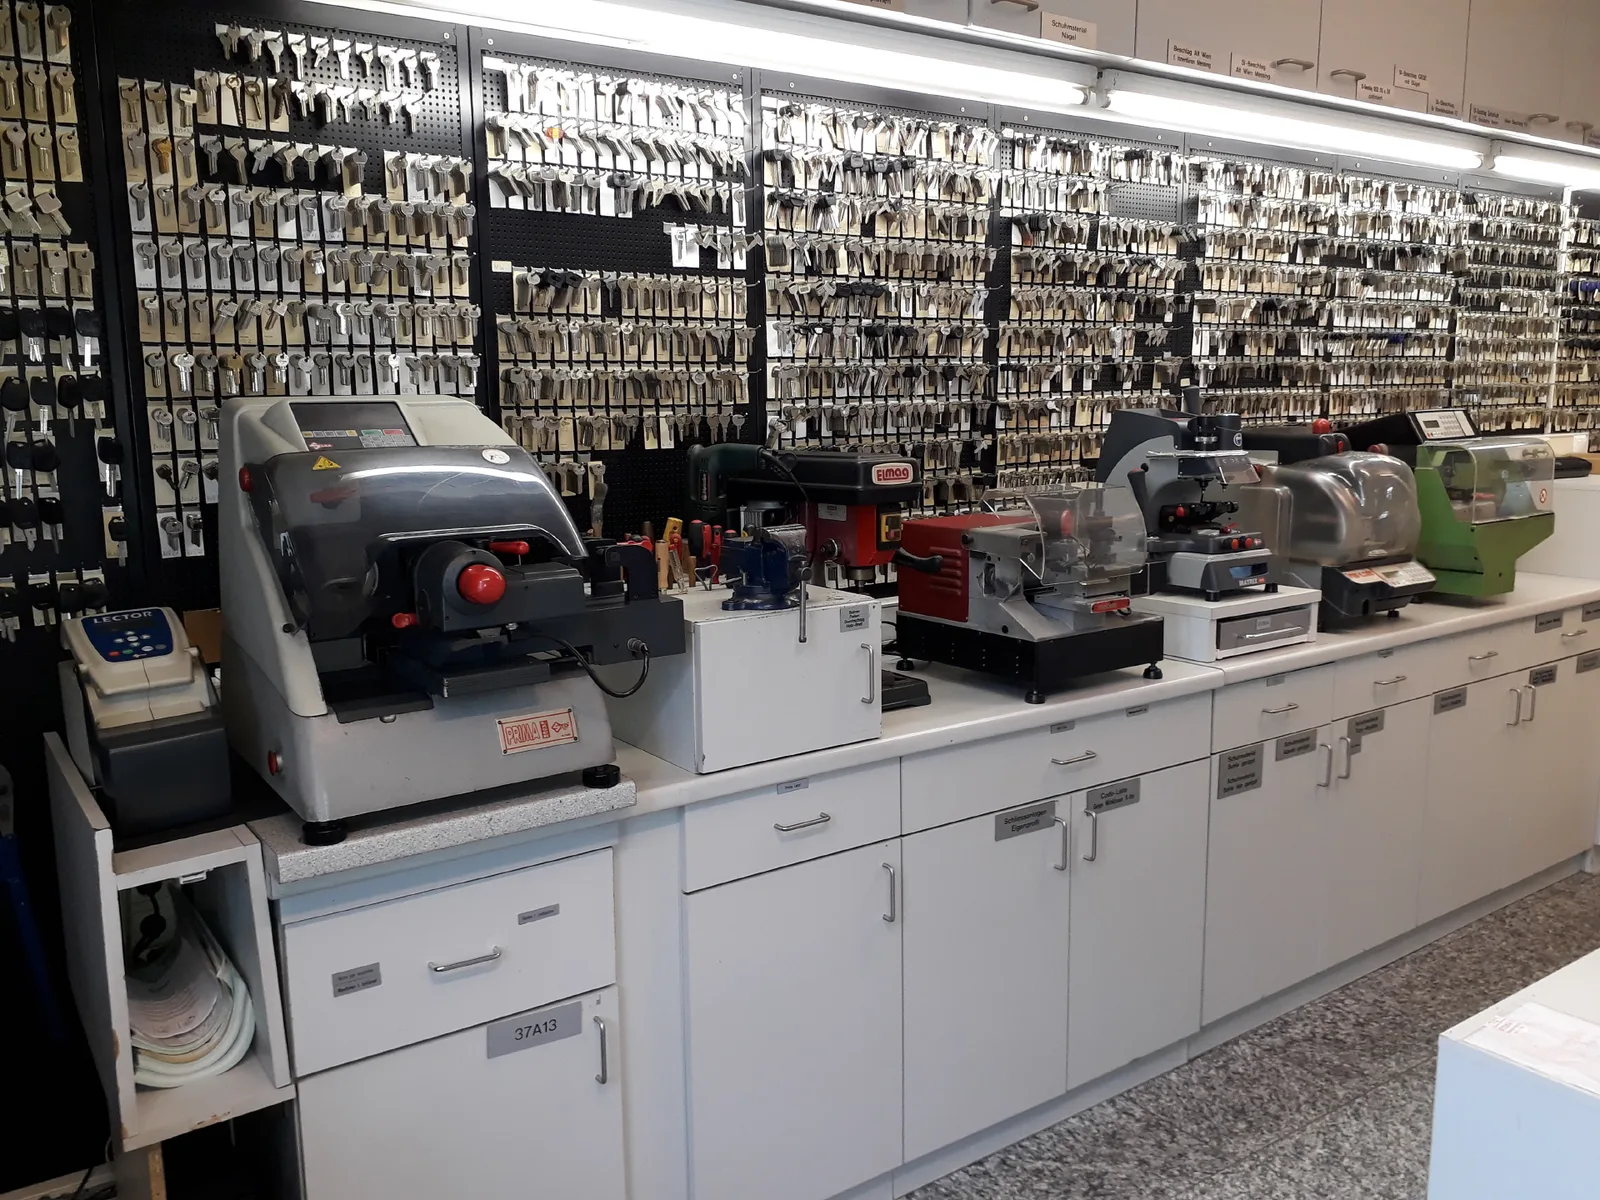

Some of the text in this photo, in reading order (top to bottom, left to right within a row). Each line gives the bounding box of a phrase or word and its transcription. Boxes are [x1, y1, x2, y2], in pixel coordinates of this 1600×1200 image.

[1051, 19, 1088, 34] Schuhmaterial
[1173, 45, 1192, 56] Beschlag
[93, 610, 153, 625] LECTOR
[505, 721, 541, 746] PRIMA
[514, 1018, 558, 1041] 37A13
